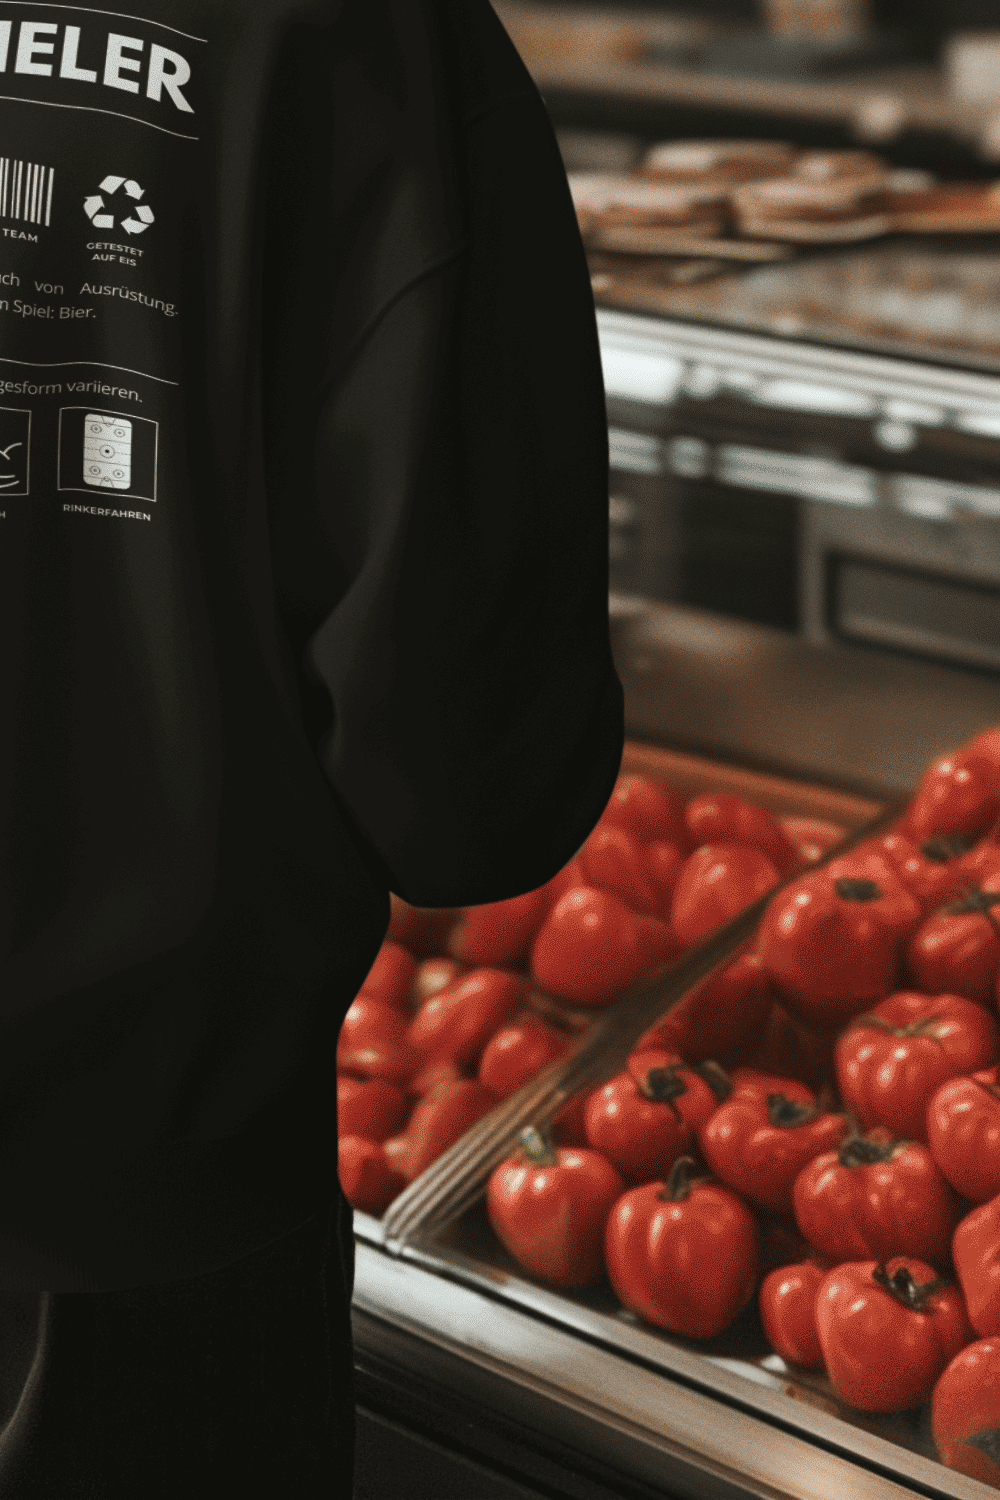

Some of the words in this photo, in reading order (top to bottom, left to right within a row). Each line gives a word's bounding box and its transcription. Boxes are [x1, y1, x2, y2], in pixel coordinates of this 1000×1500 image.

[3, 228, 38, 243] TEAM
[86, 241, 144, 258] GETESTET
[92, 253, 115, 262] AUF
[119, 256, 137, 267] EIS
[35, 282, 63, 294] von
[79, 281, 179, 317] Ausrüstung.
[13, 300, 54, 318] Spiel:
[60, 307, 95, 318] Bier.
[67, 382, 142, 402] variieren.
[63, 504, 151, 521] RINKERFAHREN
